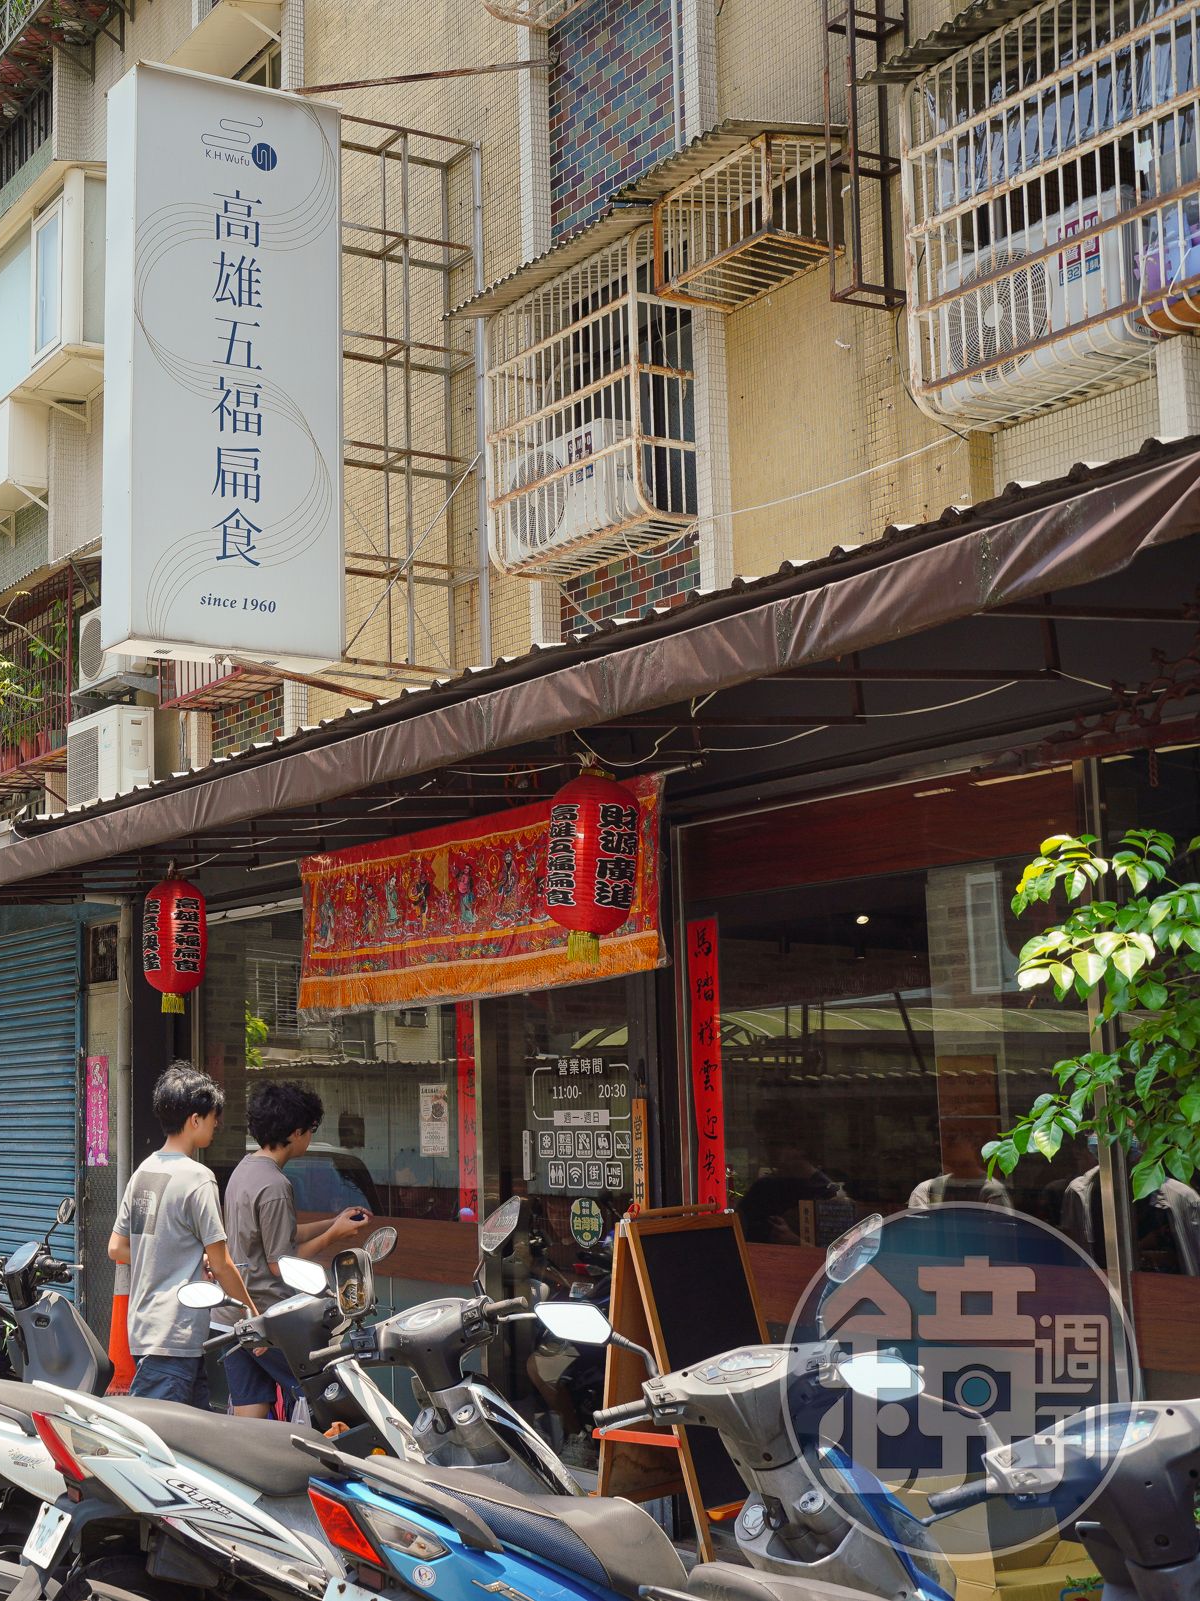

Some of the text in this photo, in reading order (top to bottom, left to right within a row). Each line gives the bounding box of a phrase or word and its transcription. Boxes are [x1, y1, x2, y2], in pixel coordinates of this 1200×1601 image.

[211, 189, 263, 568] 高雄五福扁食
[200, 593, 276, 613] since 1960
[546, 803, 581, 906] 高雄五福扁食
[593, 803, 639, 910] 財源廣進
[173, 897, 201, 973] 高雄五福扁食
[558, 1058, 603, 1075] 營業時間
[598, 1083, 627, 1098] 20:30
[606, 1167, 621, 1176] LINE
[608, 1176, 620, 1186] Pay
[635, 1115, 644, 1203] 營業中
